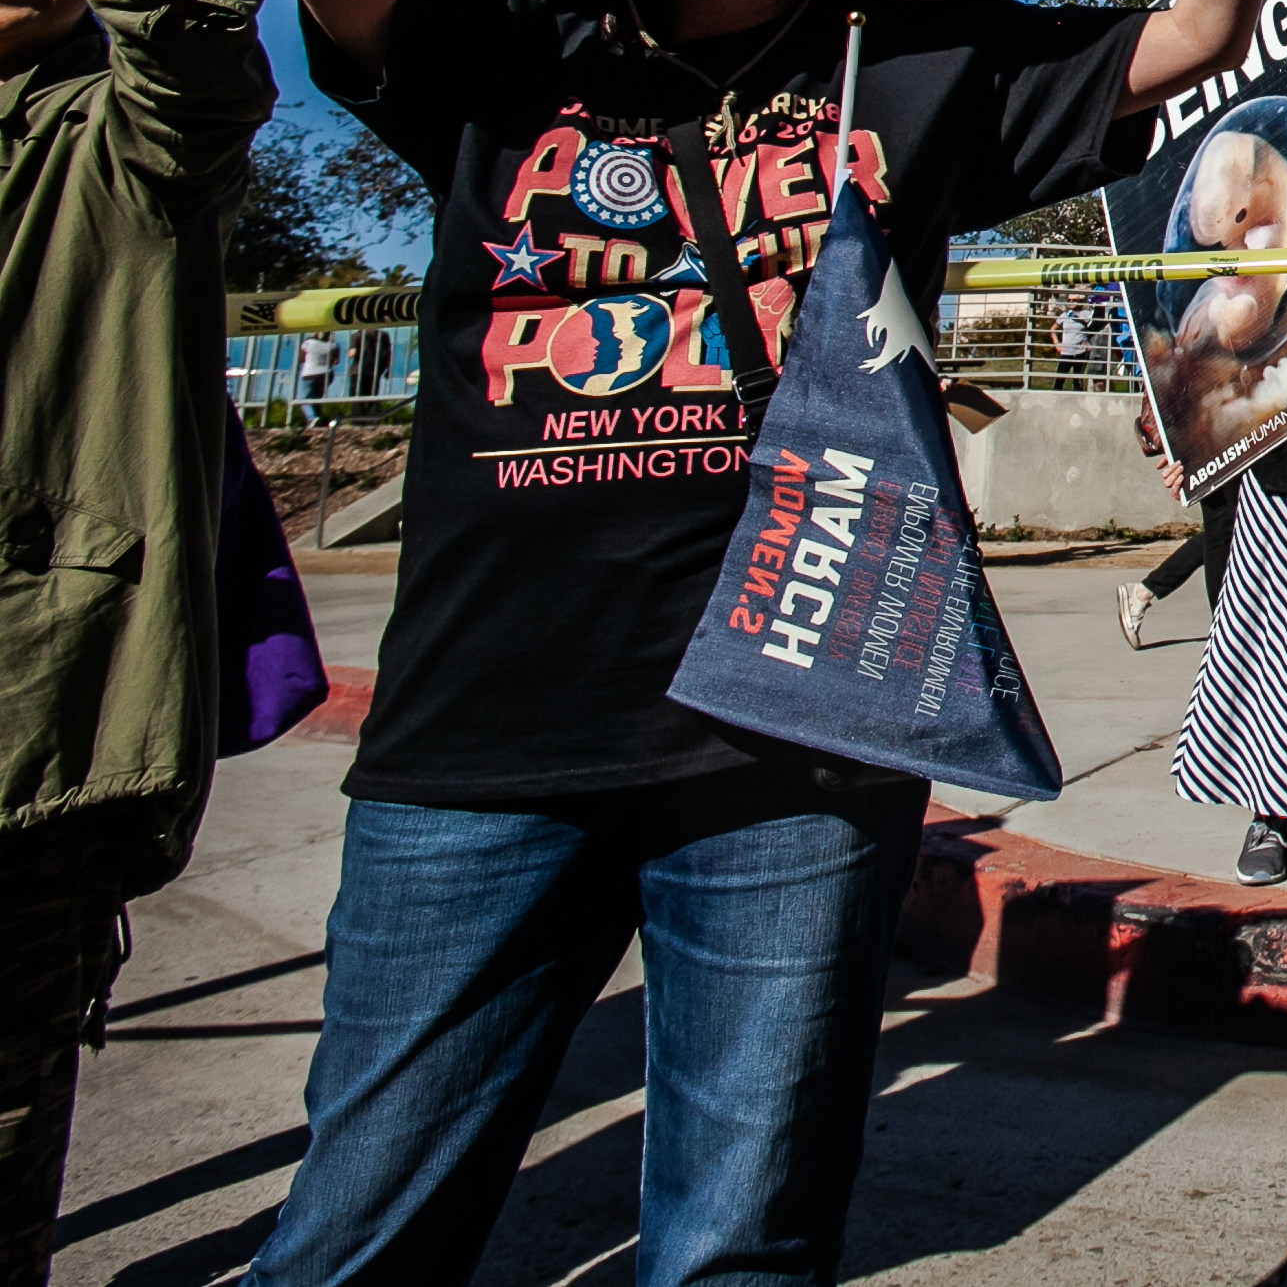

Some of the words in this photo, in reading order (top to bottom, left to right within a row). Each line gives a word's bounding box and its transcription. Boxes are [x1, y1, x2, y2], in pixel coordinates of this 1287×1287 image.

[559, 232, 648, 289] TO
[544, 408, 629, 443] NEW
[631, 404, 728, 437] YORK
